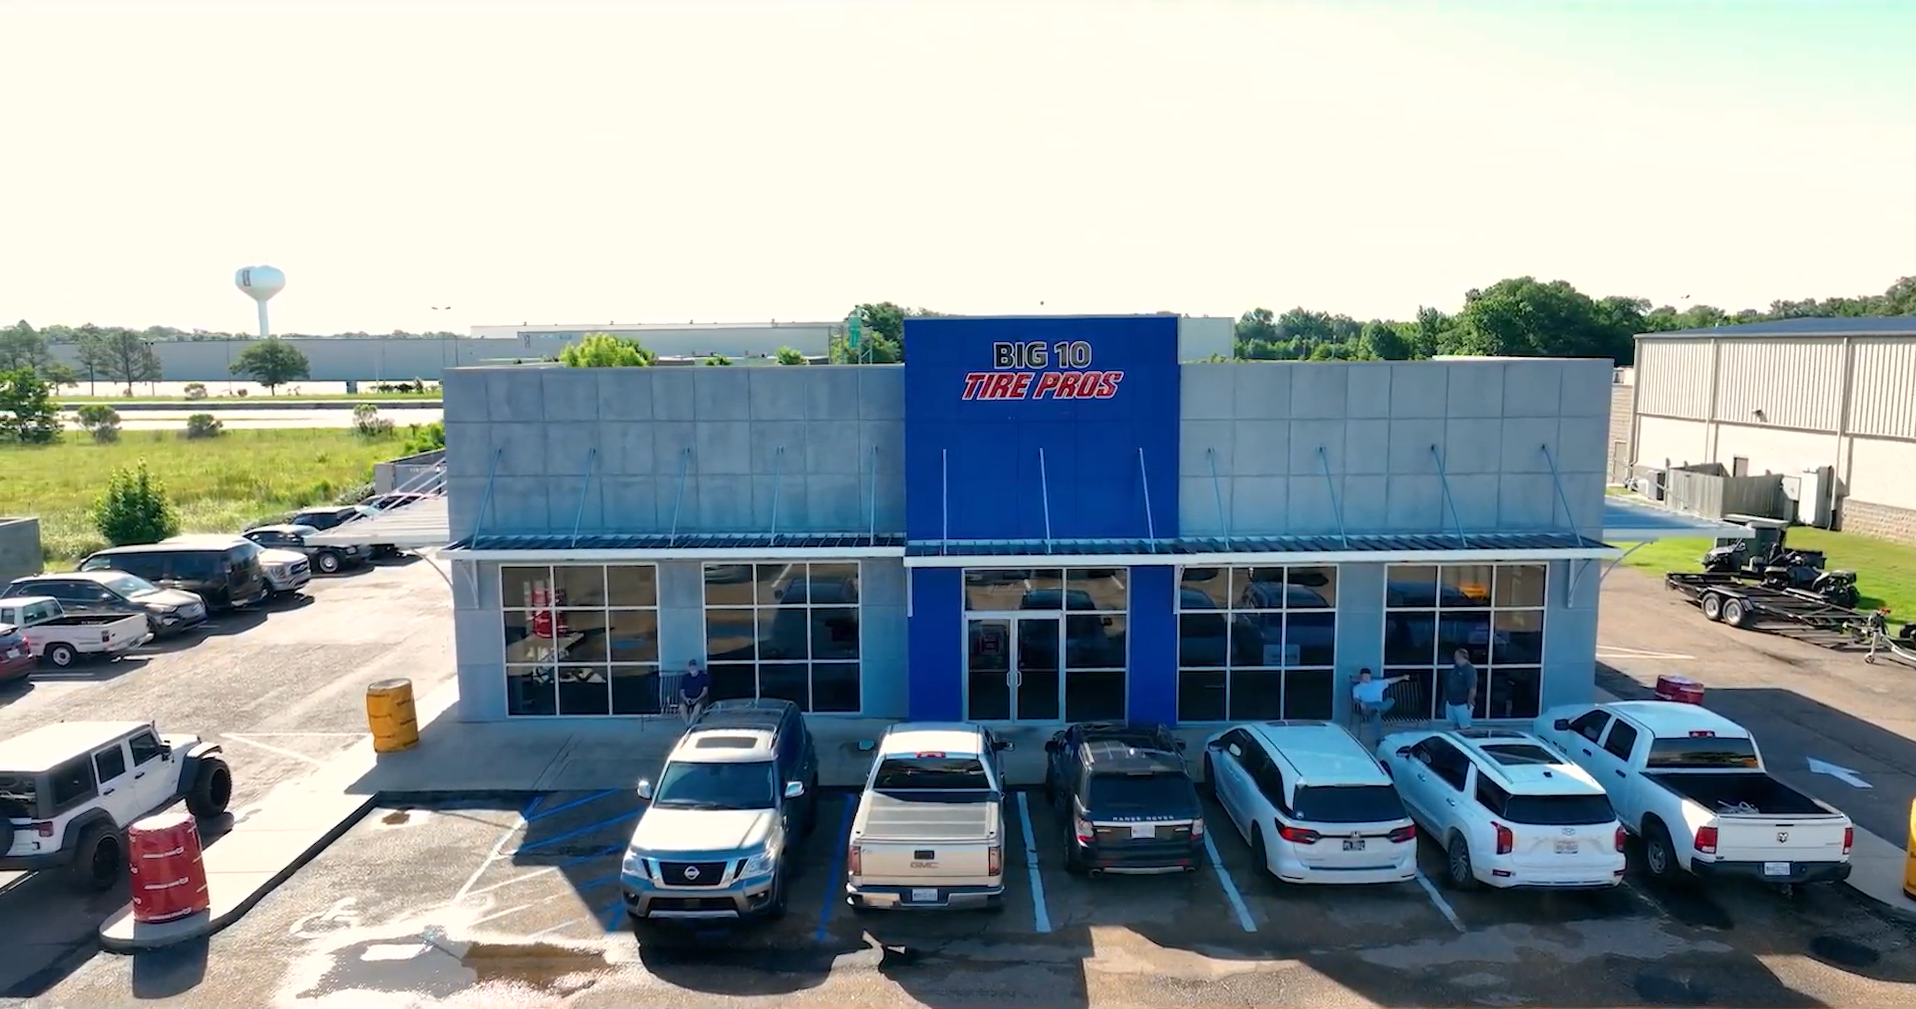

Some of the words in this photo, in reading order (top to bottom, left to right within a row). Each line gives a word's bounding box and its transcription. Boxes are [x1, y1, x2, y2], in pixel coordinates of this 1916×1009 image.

[993, 341, 1049, 369] BIG
[1054, 341, 1092, 368] 10
[962, 372, 1035, 400] TIRE
[1033, 371, 1124, 400] PROS
[910, 861, 939, 869] GMC
